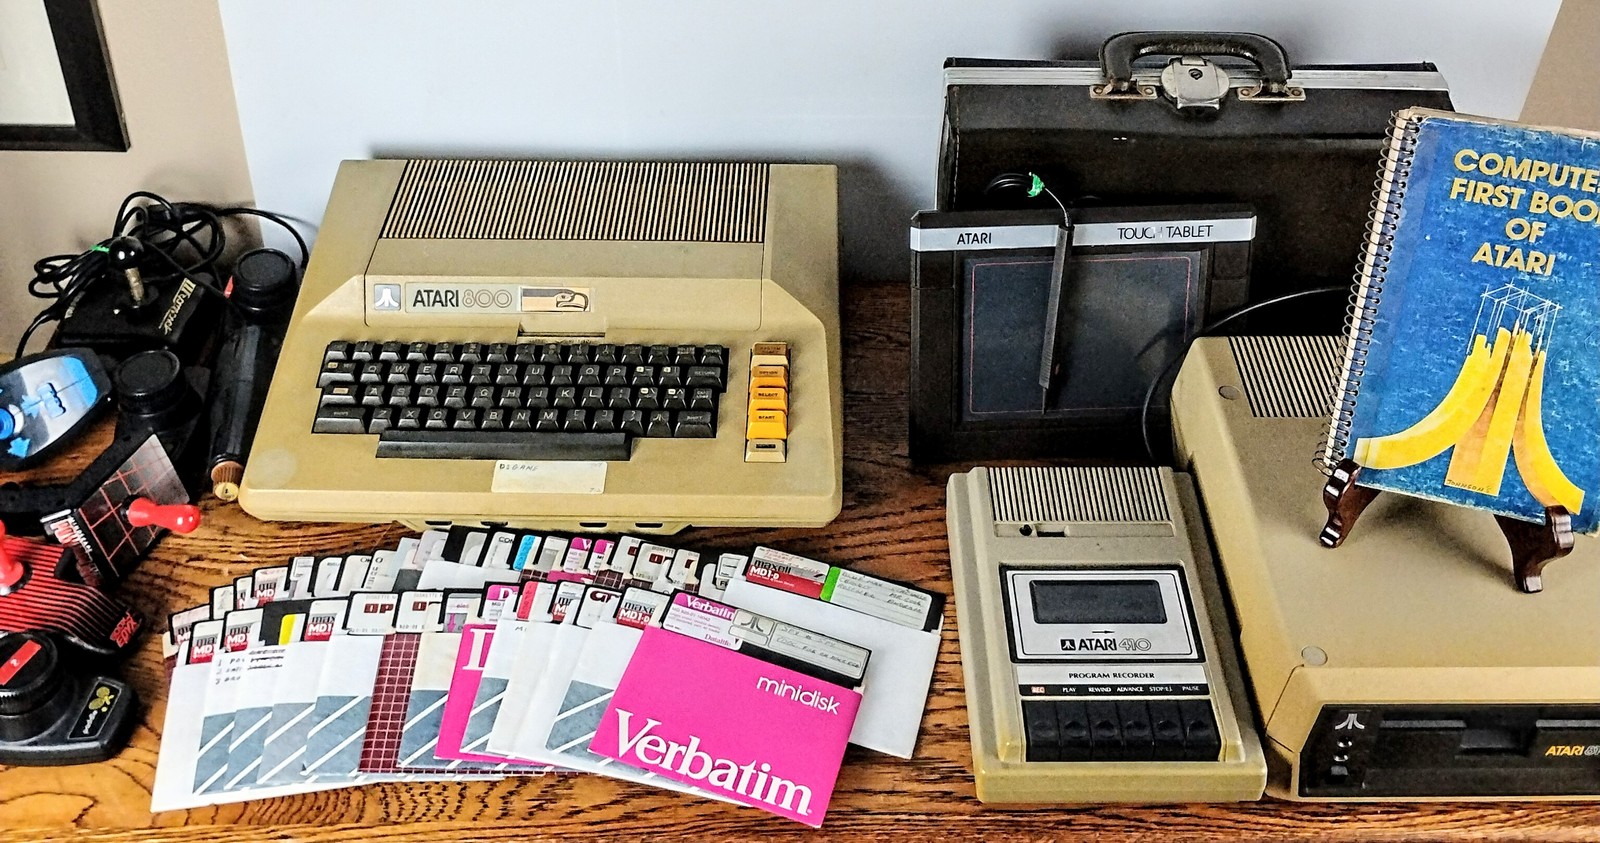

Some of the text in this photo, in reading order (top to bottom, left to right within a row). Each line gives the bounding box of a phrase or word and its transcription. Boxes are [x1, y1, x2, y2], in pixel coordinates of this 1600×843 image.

[1454, 149, 1600, 194] COMPUTE
[1450, 177, 1600, 225] FIRST BOO
[956, 232, 992, 245] ATARI
[1166, 225, 1214, 238] TABLET
[1505, 217, 1547, 243] OF
[1471, 242, 1556, 276] ATARI
[412, 289, 512, 308] ATARI 800
[754, 559, 791, 574] maxell
[1078, 637, 1152, 651] ATARI 410
[757, 675, 841, 715] minidisk
[615, 707, 812, 816] Verbatim
[1545, 745, 1585, 756] ATARI
